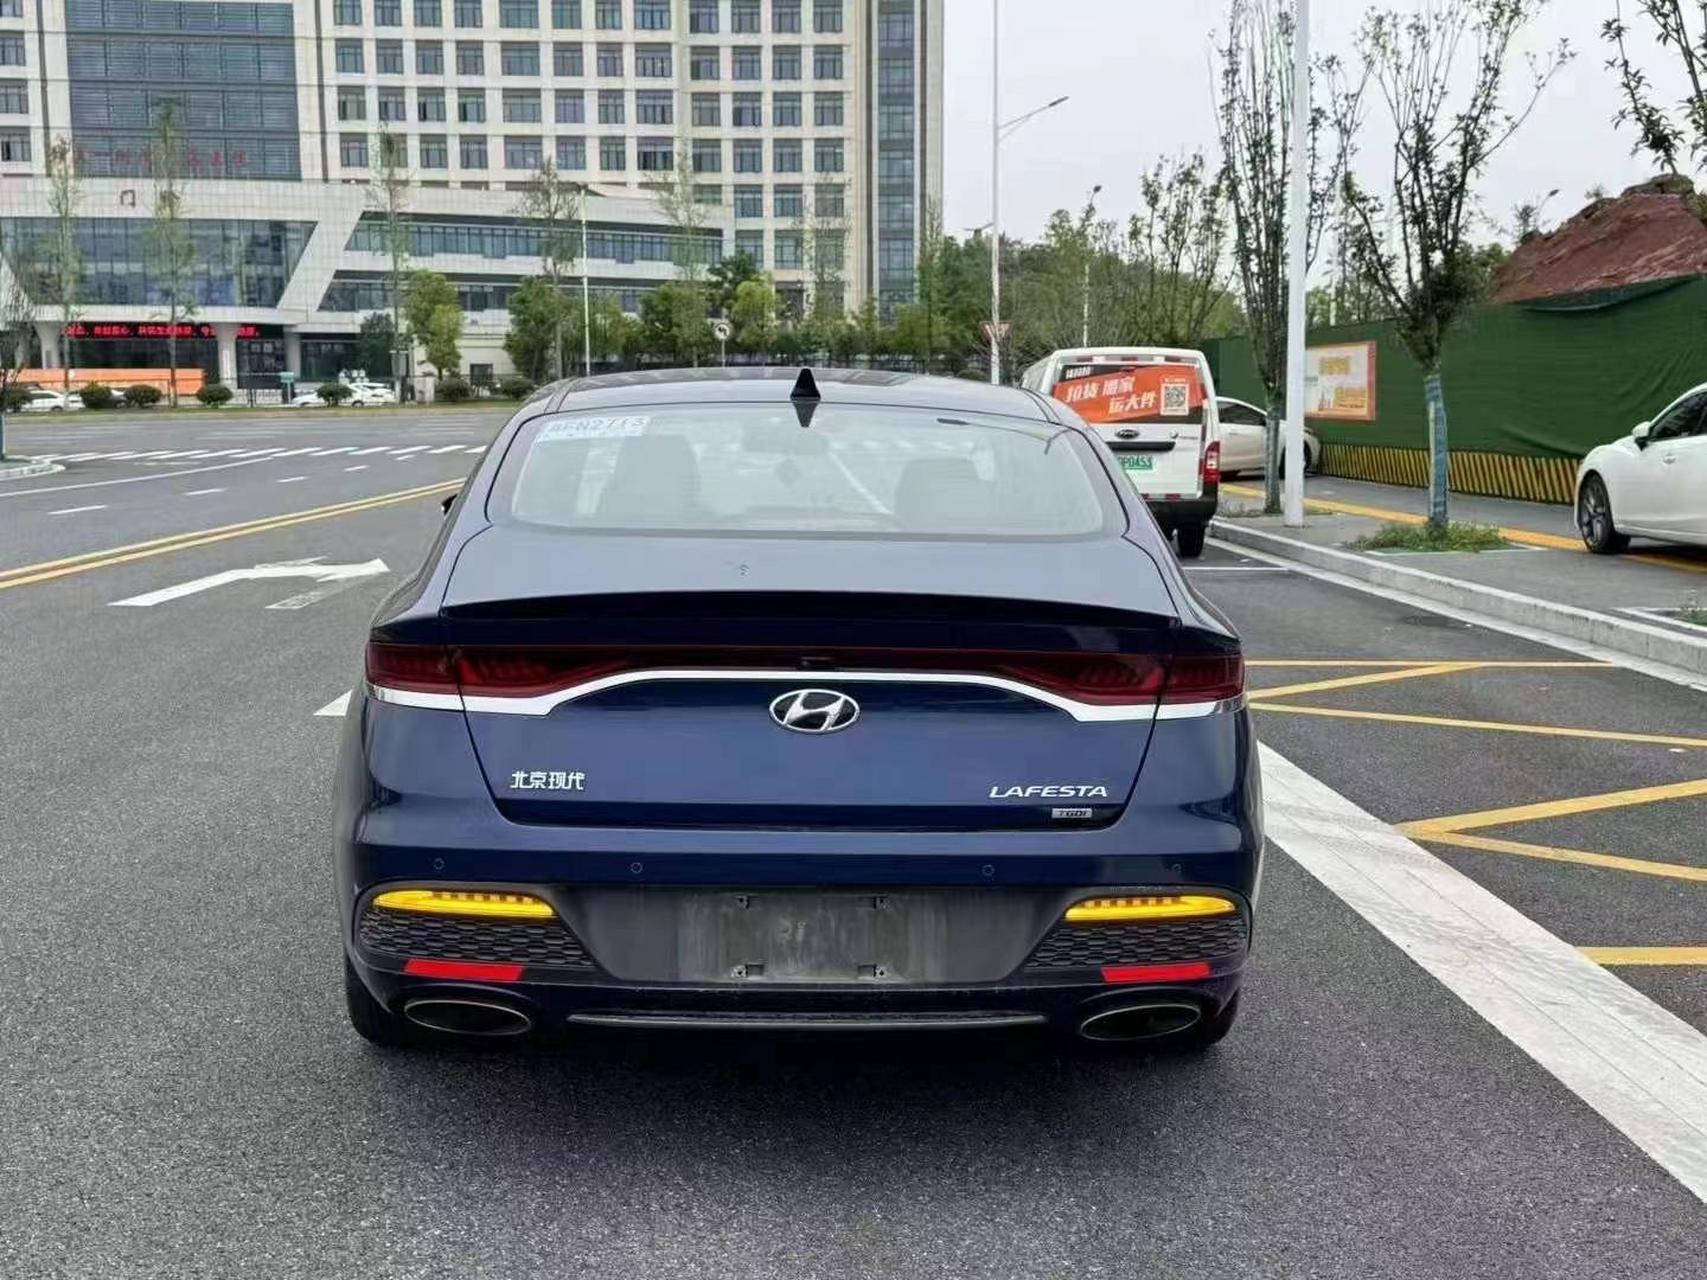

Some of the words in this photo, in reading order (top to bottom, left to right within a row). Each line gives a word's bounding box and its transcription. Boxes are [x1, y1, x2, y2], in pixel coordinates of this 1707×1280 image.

[510, 771, 586, 790] 北京现代
[989, 785, 1108, 798] LAFESTA
